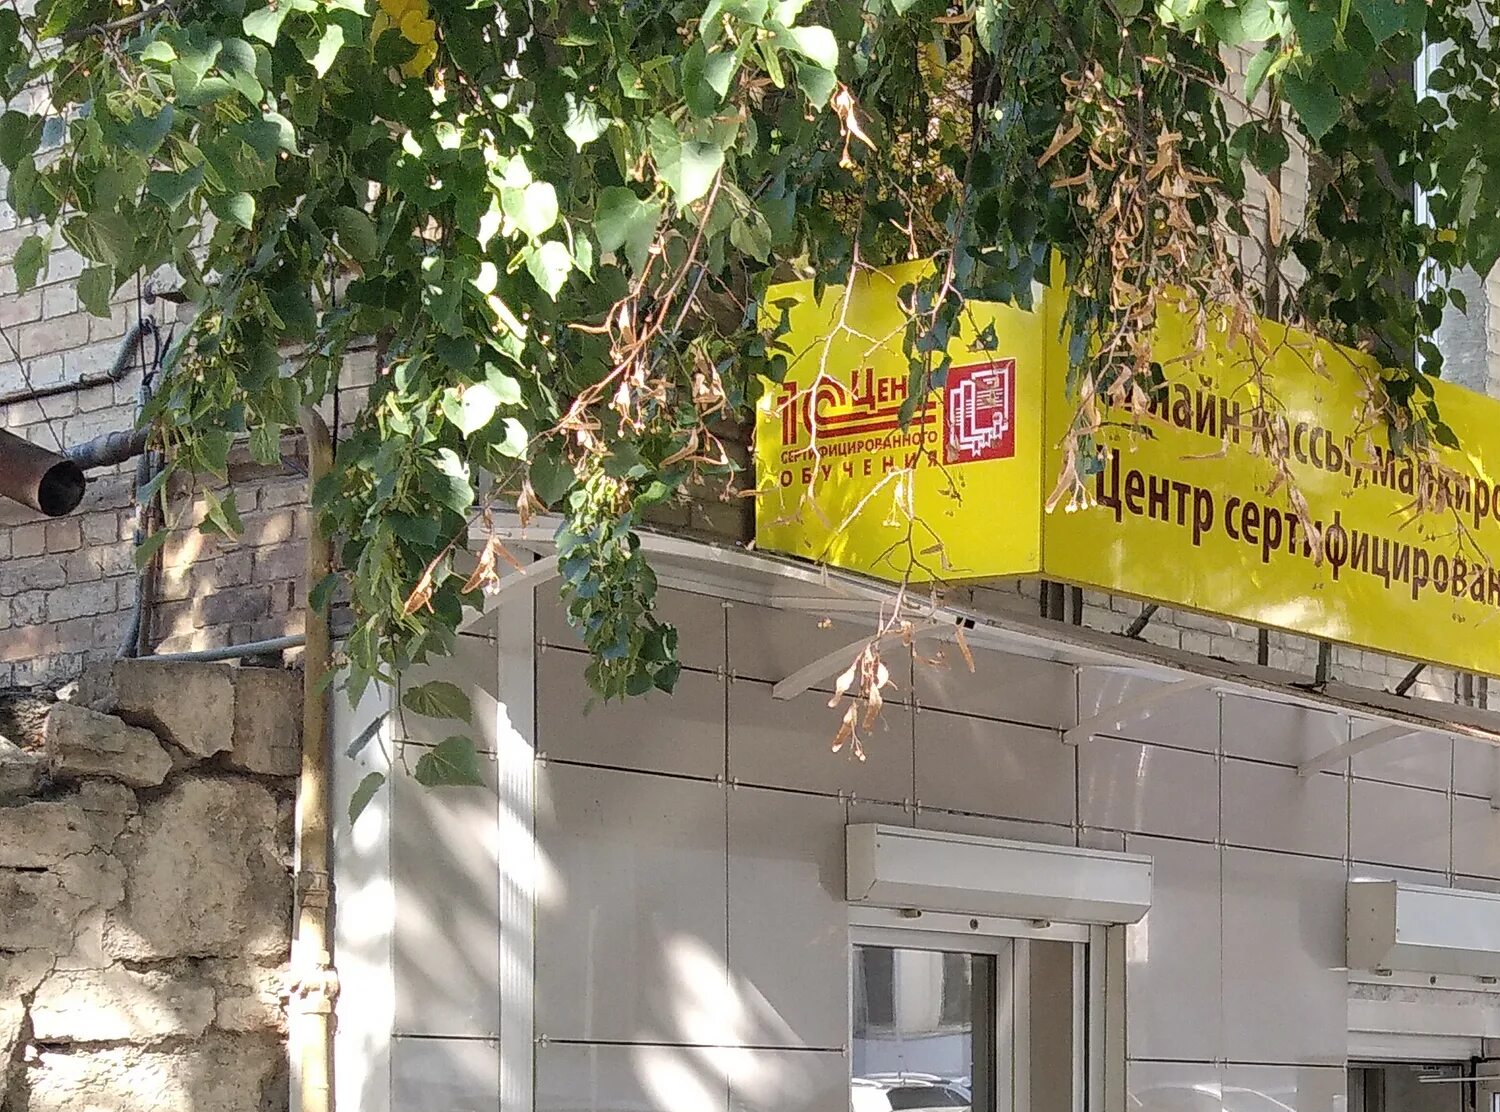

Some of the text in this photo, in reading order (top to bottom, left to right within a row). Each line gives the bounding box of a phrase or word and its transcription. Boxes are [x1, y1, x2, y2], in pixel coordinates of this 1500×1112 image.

[1096, 364, 1240, 444] лайн
[780, 430, 938, 465] СЕРТИФИЦИРОВАННОГО
[1095, 443, 1214, 547] Центр
